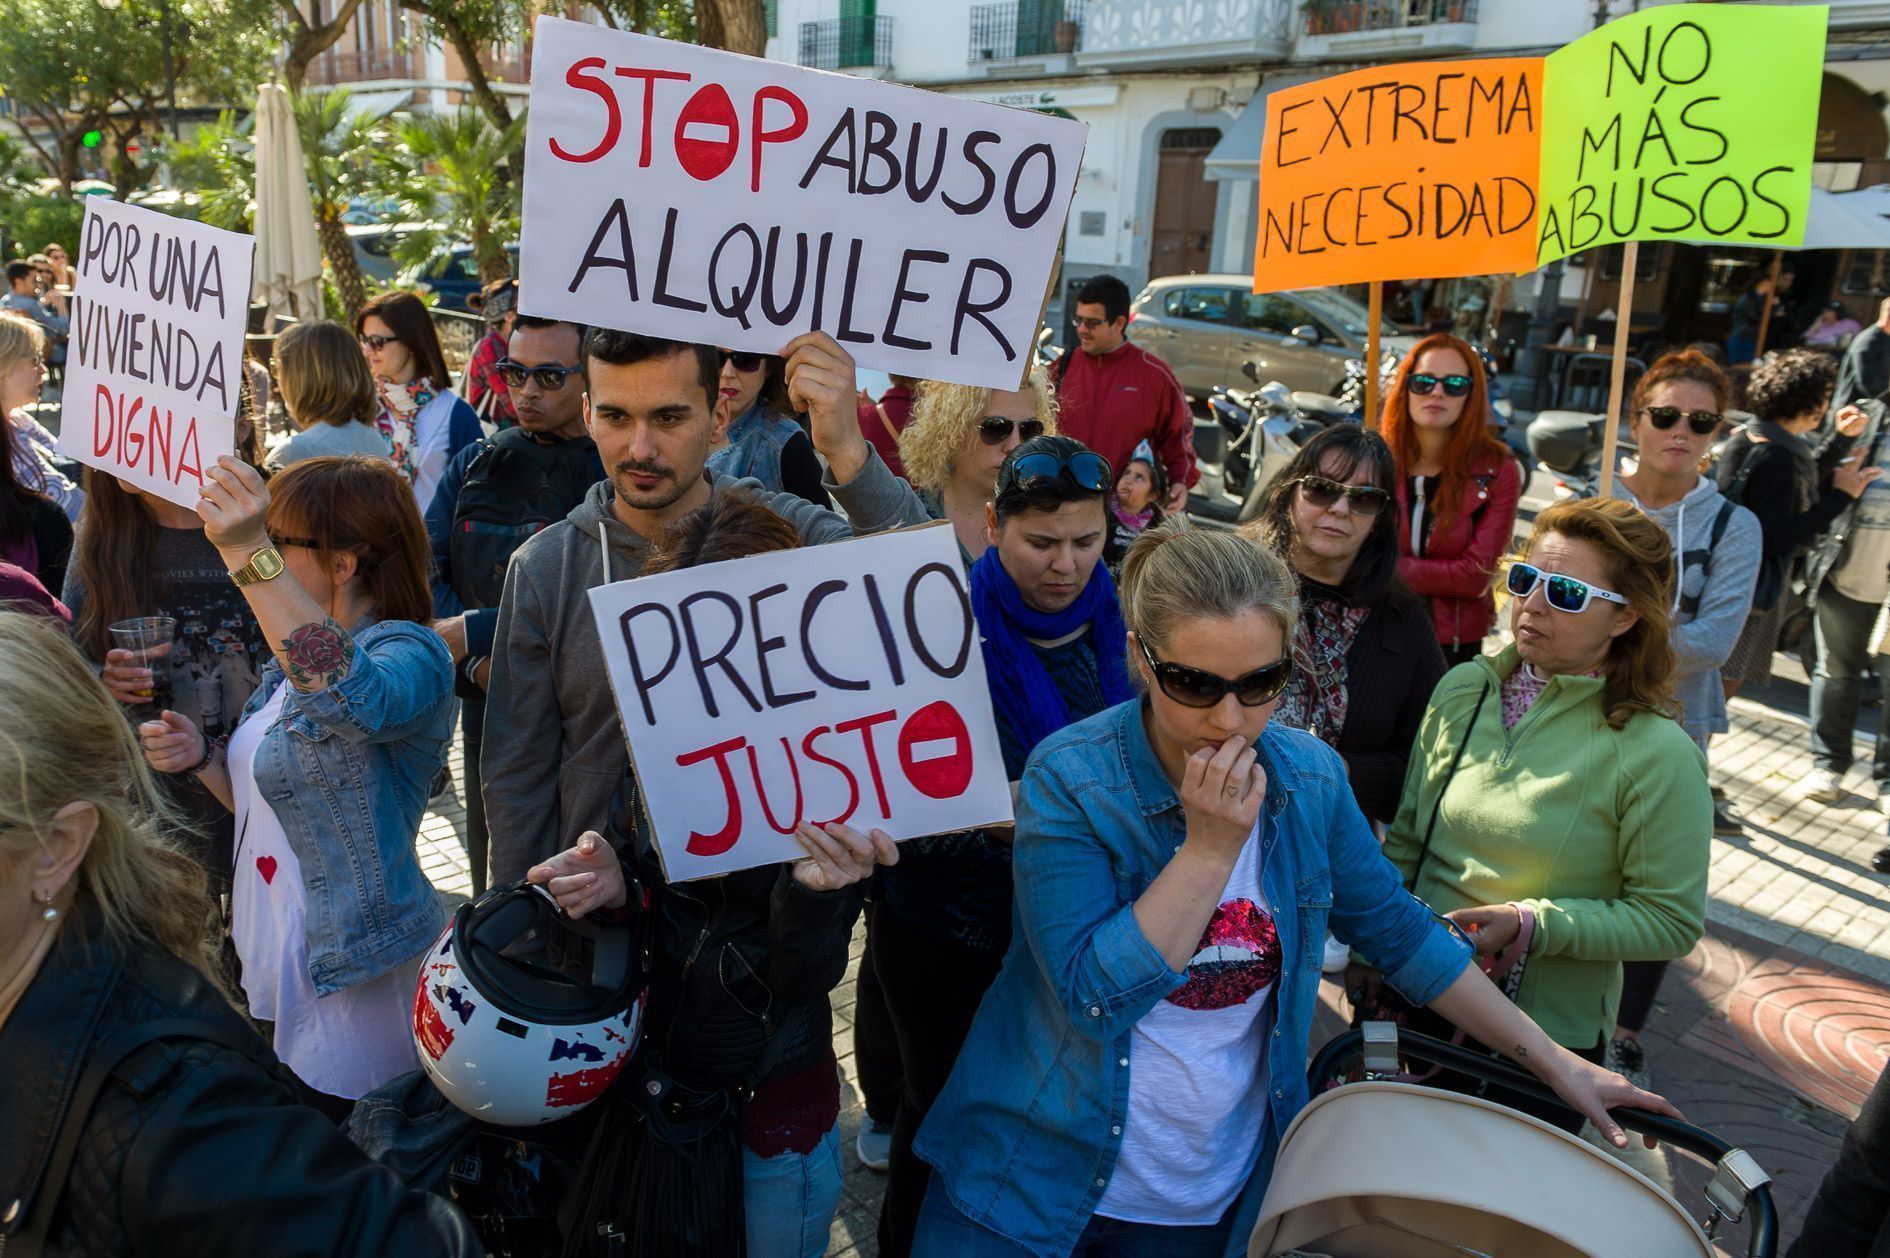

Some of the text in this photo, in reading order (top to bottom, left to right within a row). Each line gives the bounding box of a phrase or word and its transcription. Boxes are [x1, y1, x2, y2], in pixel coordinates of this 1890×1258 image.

[1606, 21, 1711, 97] NO
[550, 57, 1057, 229] STOP ABUSO
[1277, 72, 1533, 167] EXTREMA
[1577, 85, 1728, 182] MÁS
[83, 212, 225, 319] POR UNA
[1537, 166, 1794, 265] ABUSOS
[568, 198, 1016, 361] ALQUILER
[76, 295, 227, 411] VIVIENDA
[93, 384, 204, 498] DIGNA
[620, 562, 973, 725] PRECIO
[676, 700, 973, 856] JUSTO
